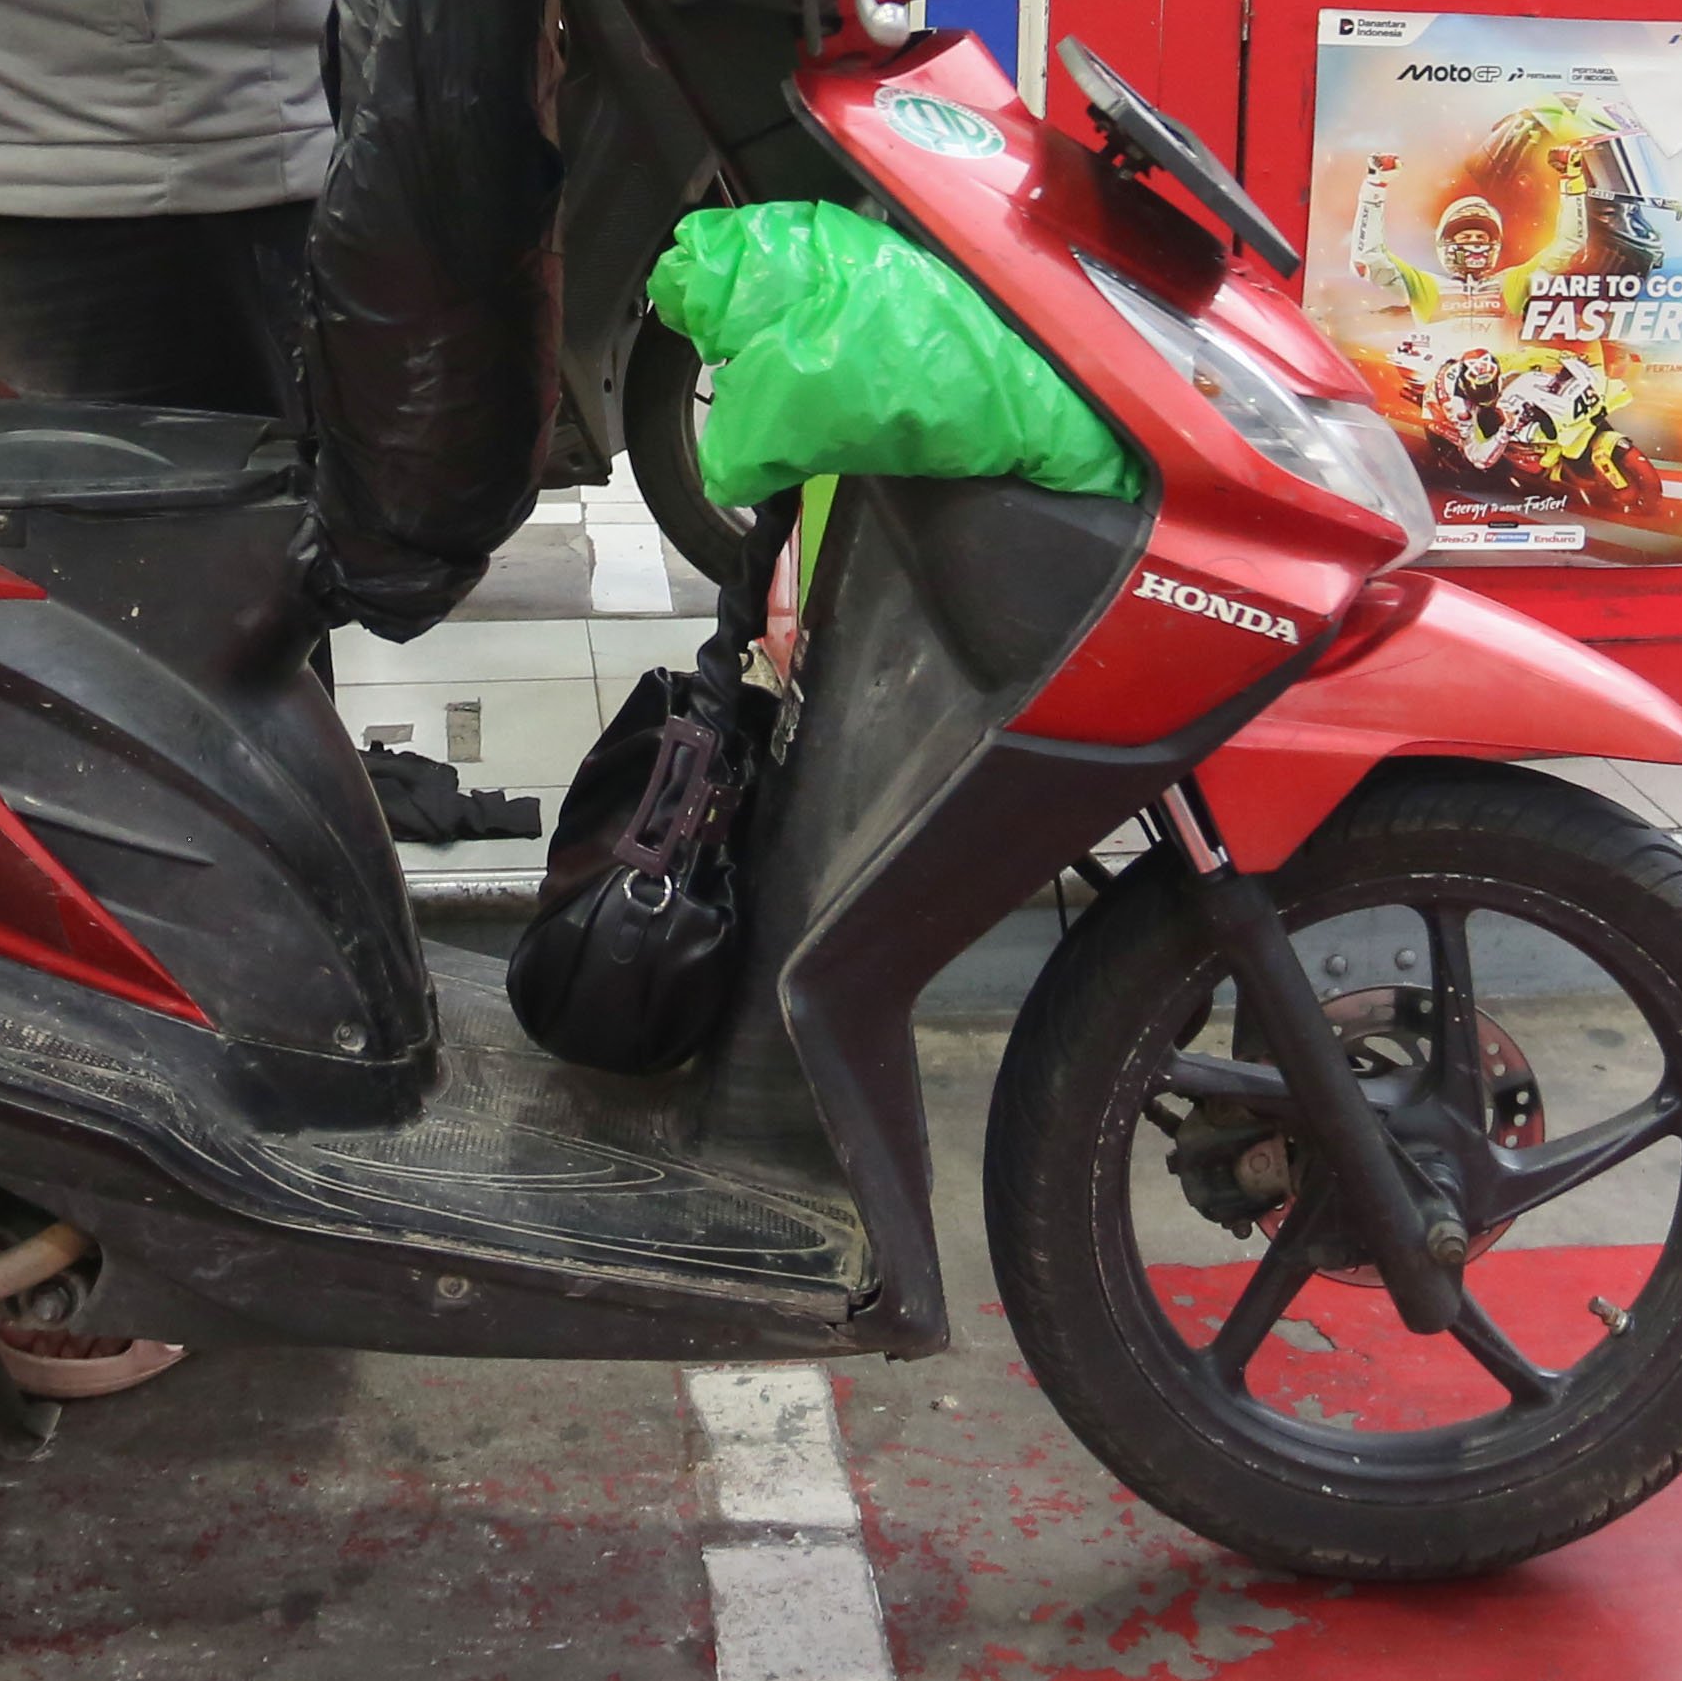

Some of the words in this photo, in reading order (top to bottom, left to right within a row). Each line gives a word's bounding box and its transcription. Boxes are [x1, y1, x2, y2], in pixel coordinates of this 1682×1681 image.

[1357, 29, 1402, 38] Indonesia
[1358, 19, 1405, 28] Danantara
[1397, 64, 1502, 82] MotoGP
[1530, 274, 1601, 297] DARE
[1606, 274, 1642, 298] TO
[1444, 500, 1489, 520] Energy
[1524, 495, 1567, 514] Faster!
[1134, 570, 1298, 645] HONDA
